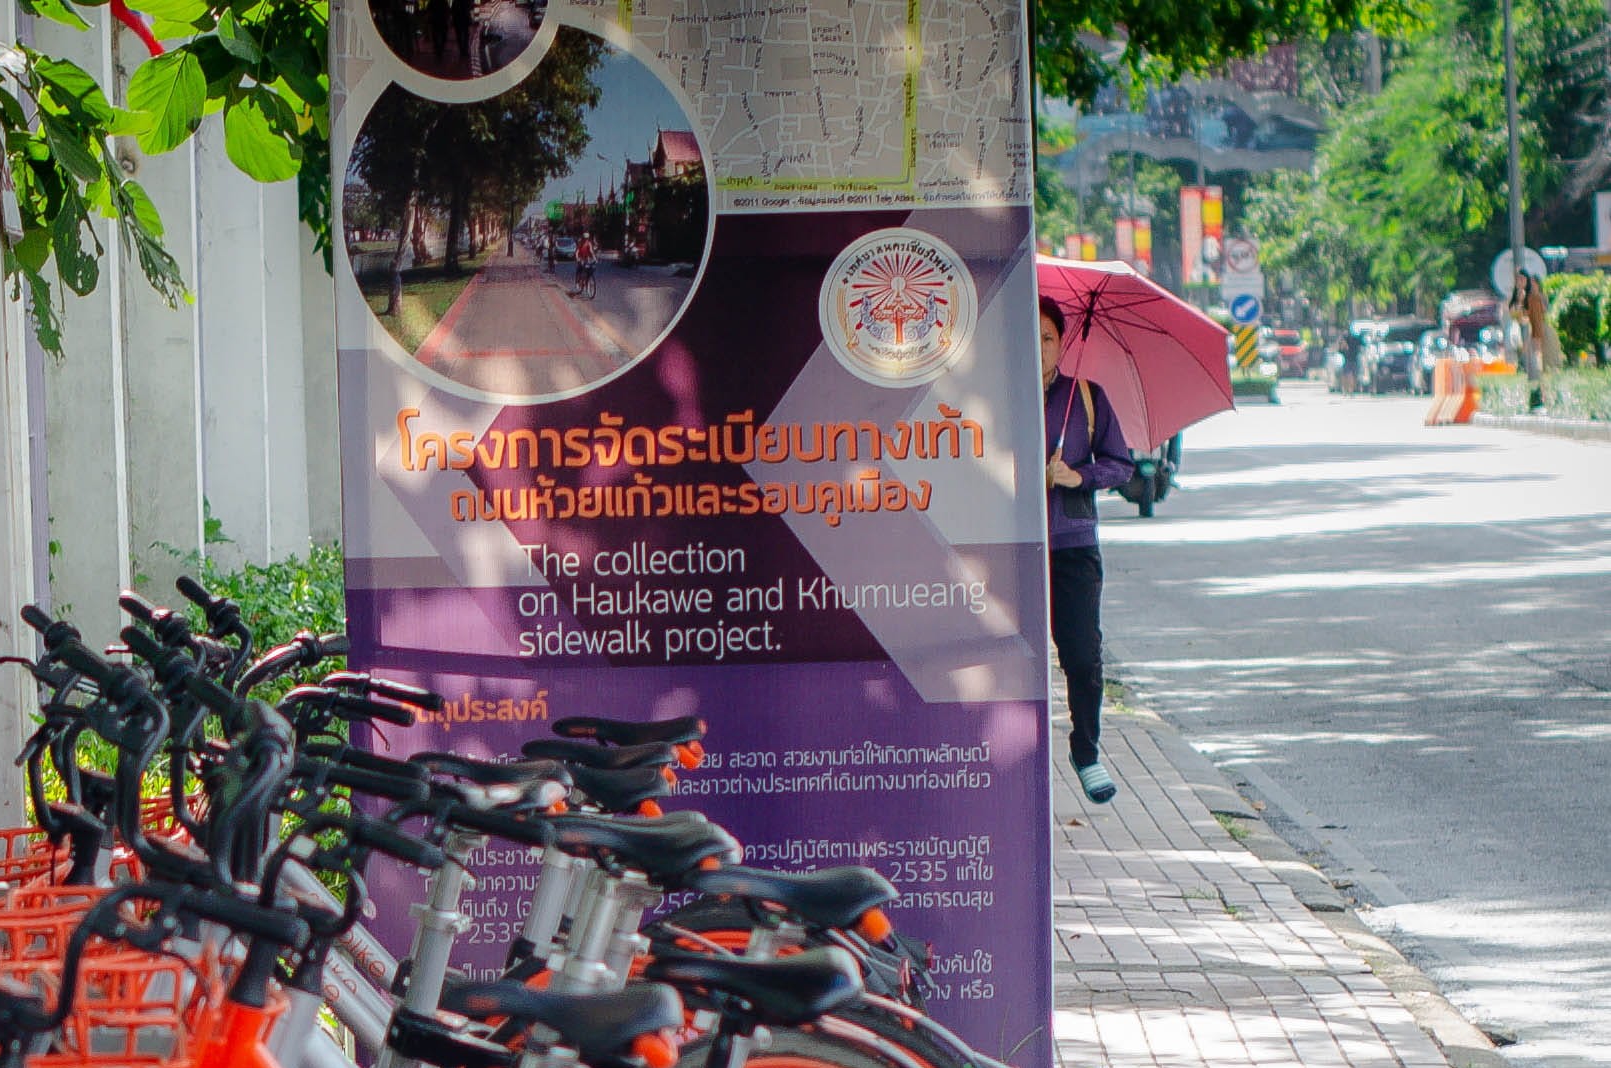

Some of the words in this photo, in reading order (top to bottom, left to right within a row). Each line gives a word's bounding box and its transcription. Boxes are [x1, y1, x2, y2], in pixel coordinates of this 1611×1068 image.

[396, 402, 985, 471] โครงการจัดระเบียบทางเท้า
[450, 472, 932, 527] ถนนห้วยแก้วและรอบคูเมือง
[520, 545, 580, 578] The
[593, 541, 746, 577] collection
[518, 590, 558, 618] on
[572, 582, 713, 616] Haukawe
[726, 579, 784, 613] and
[798, 576, 988, 615] Khumueang
[518, 622, 651, 657] sidewalk
[665, 619, 781, 661] project.
[889, 860, 948, 884] 2535
